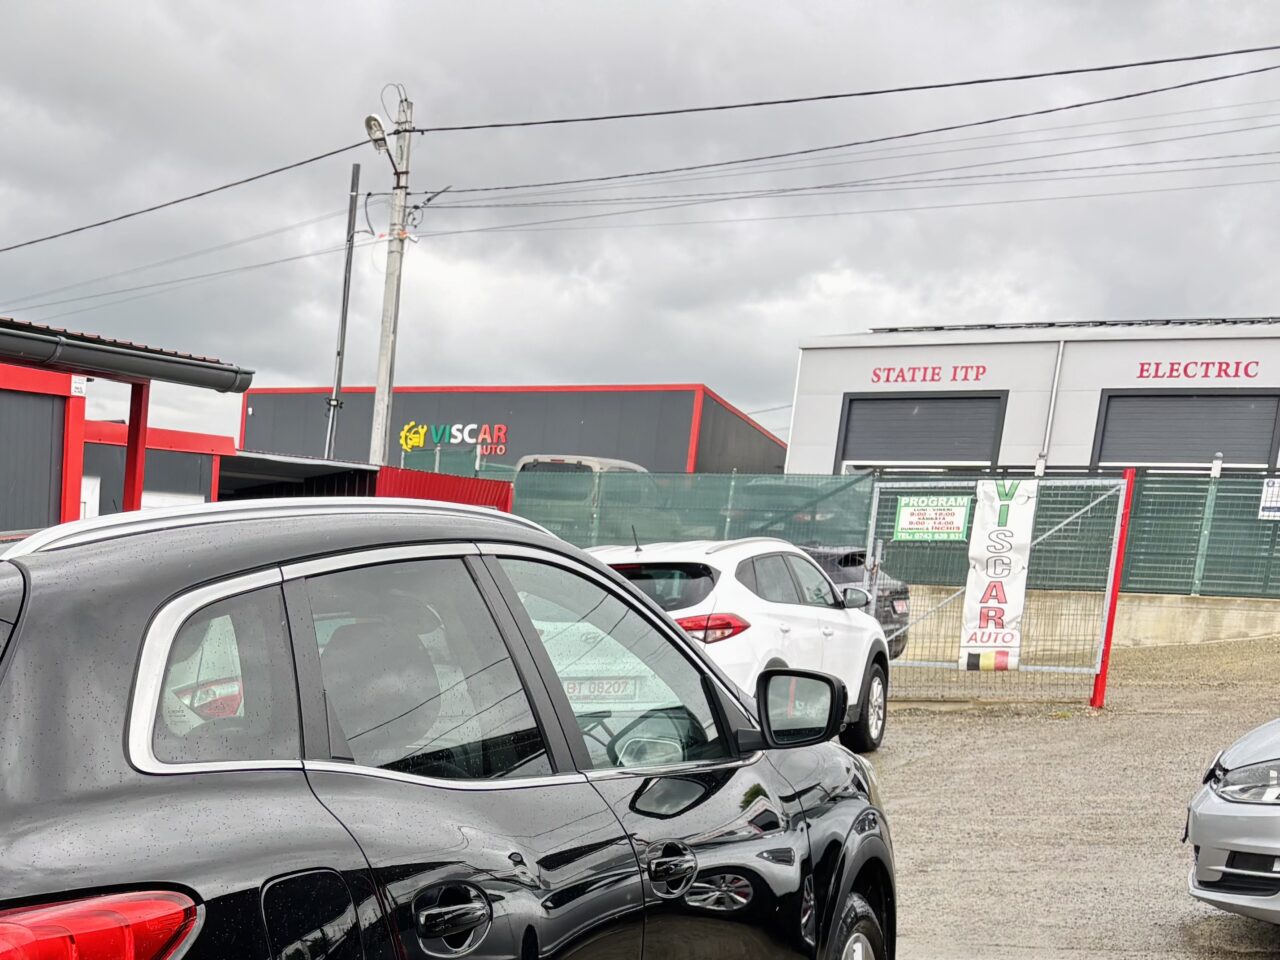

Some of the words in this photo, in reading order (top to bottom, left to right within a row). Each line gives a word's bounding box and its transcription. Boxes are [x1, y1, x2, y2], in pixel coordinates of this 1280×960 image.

[871, 366, 942, 383] STATIE
[950, 365, 987, 381] ITP
[1136, 361, 1259, 379] ELECTRIC
[430, 423, 508, 444] VISCAR
[900, 496, 968, 507] PROGRAM
[979, 480, 1021, 629] VISCAR
[967, 631, 1014, 644] AUTO
